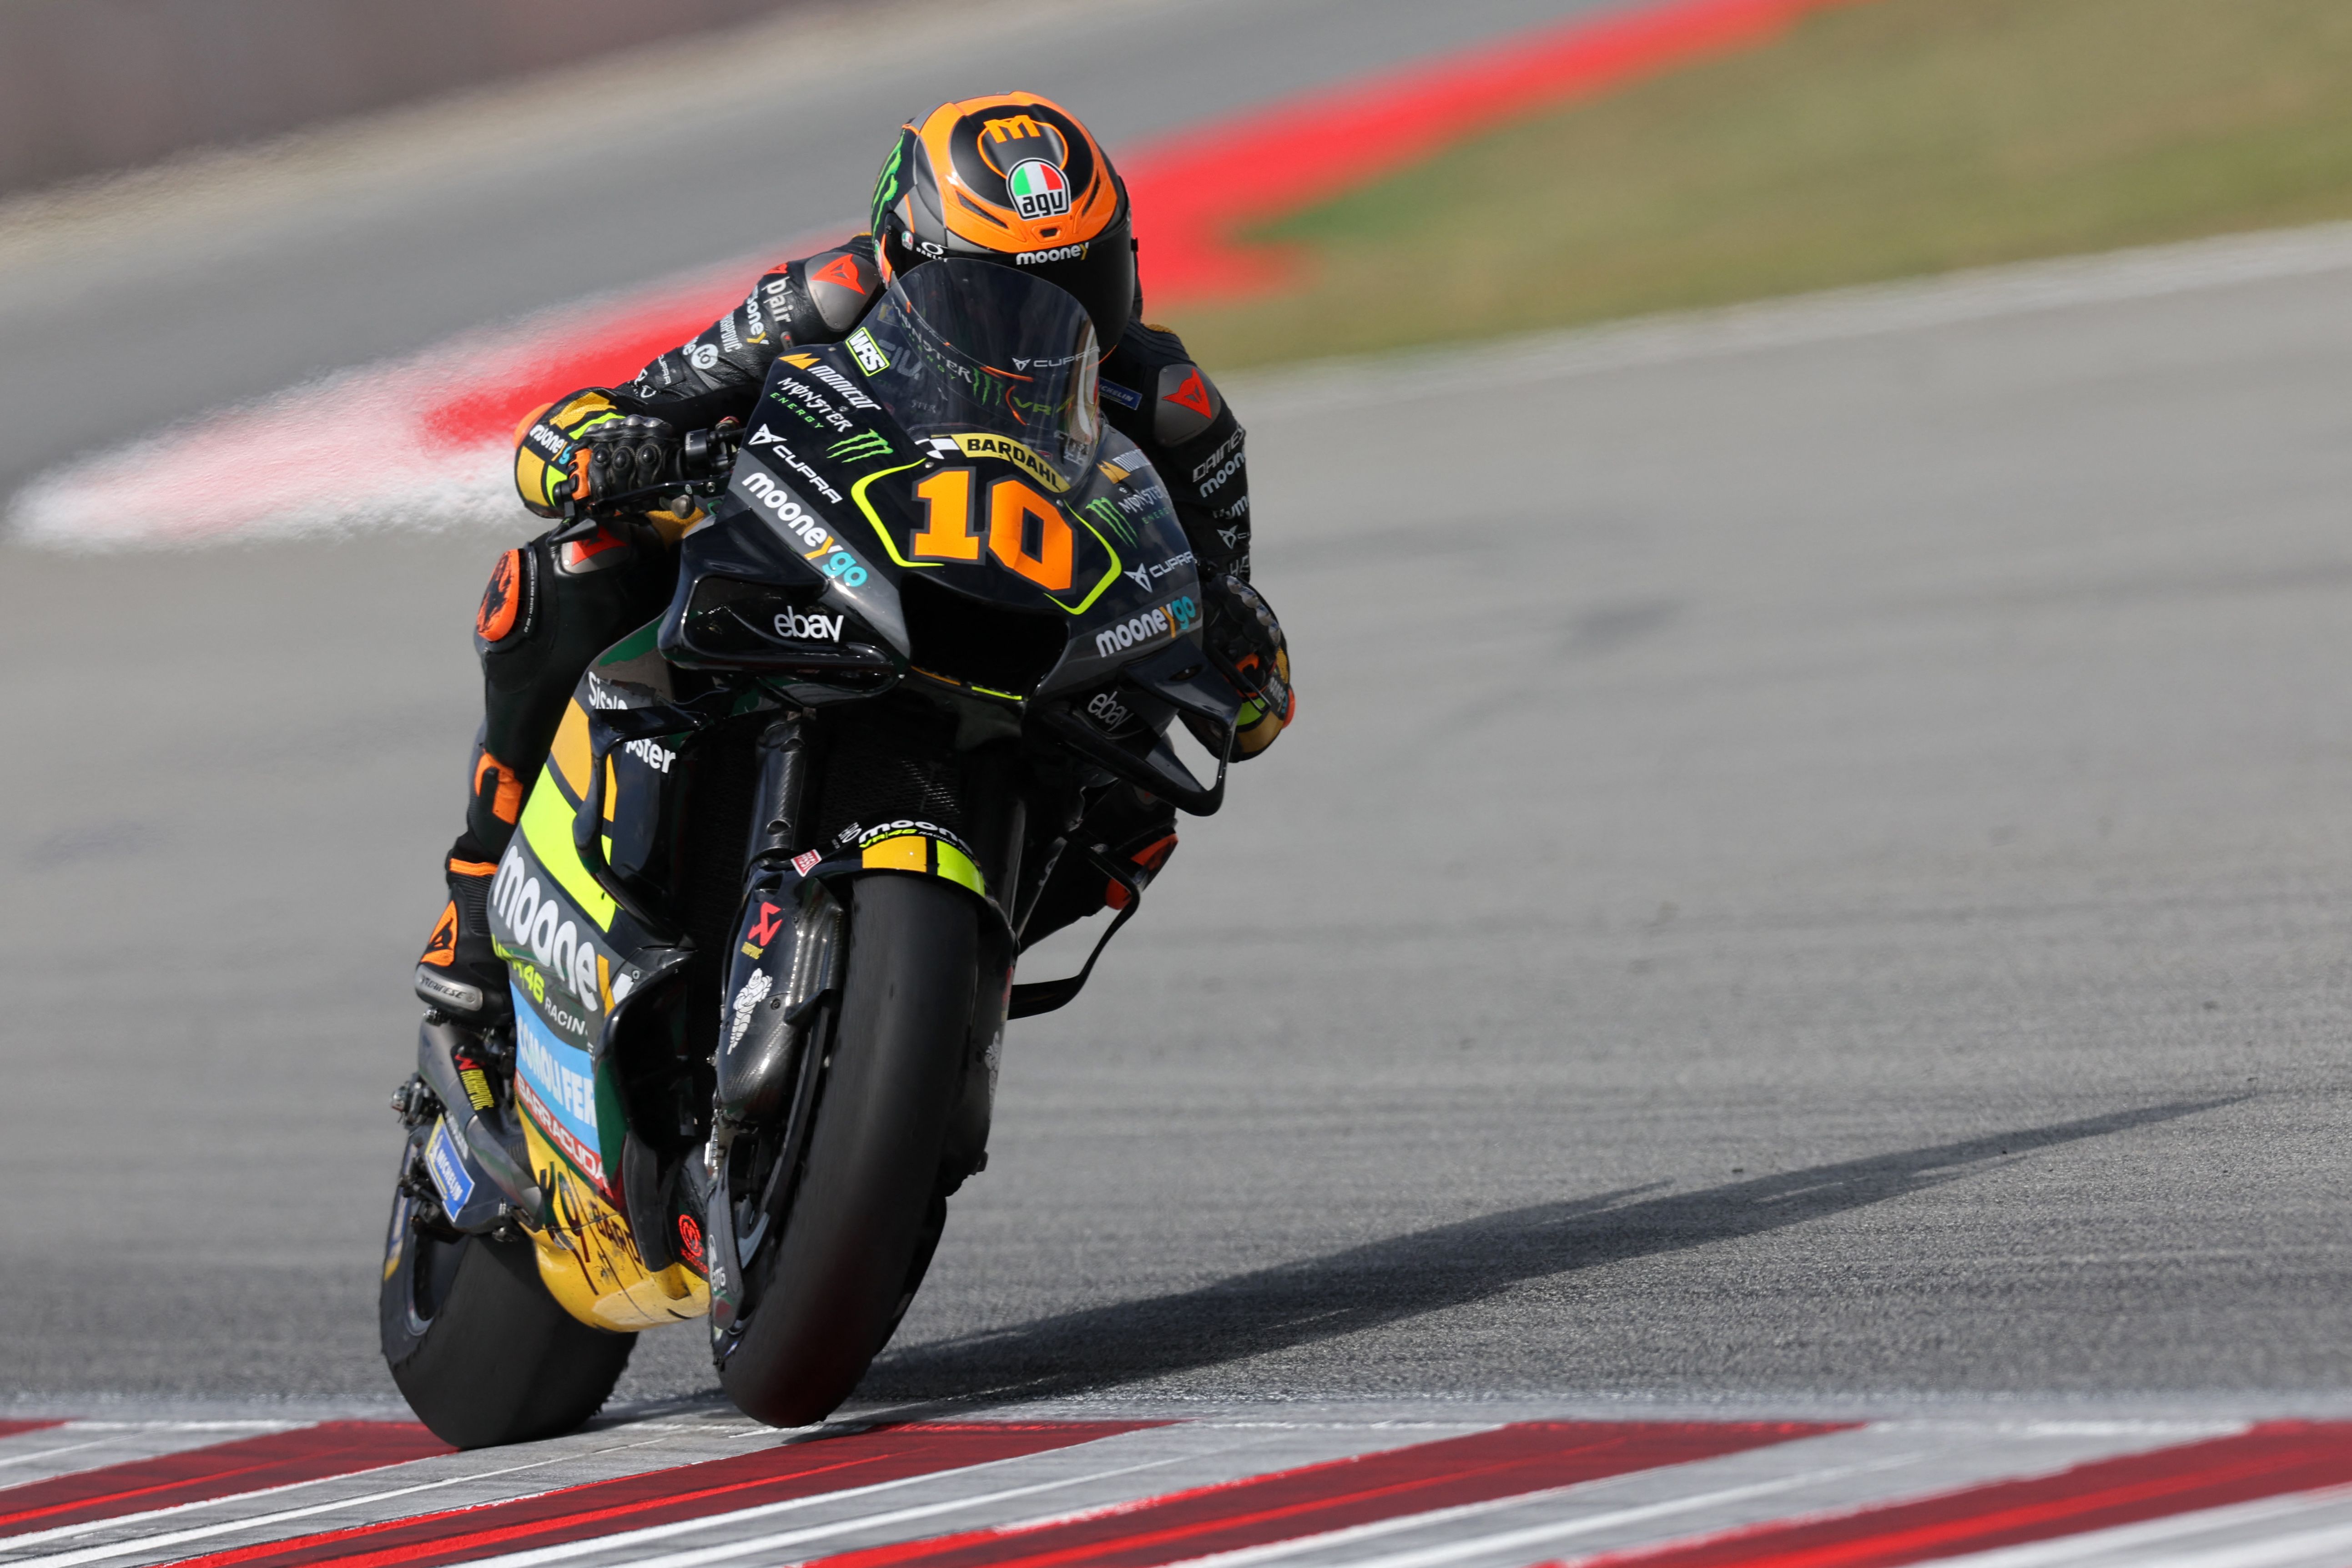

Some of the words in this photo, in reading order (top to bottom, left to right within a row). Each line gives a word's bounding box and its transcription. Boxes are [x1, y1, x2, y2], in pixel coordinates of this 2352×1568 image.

[1022, 192, 1063, 216] agv
[1016, 242, 1090, 265] mooney
[849, 330, 886, 371] WRS
[770, 393, 824, 429] ENERGY
[773, 444, 842, 504] CUPRA
[967, 438, 1061, 491] BARDAHL
[1199, 444, 1245, 498] moon
[914, 470, 1073, 590] 10
[774, 605, 844, 643] ebay
[1087, 691, 1134, 732] ebay
[545, 996, 588, 1036] RACIN
